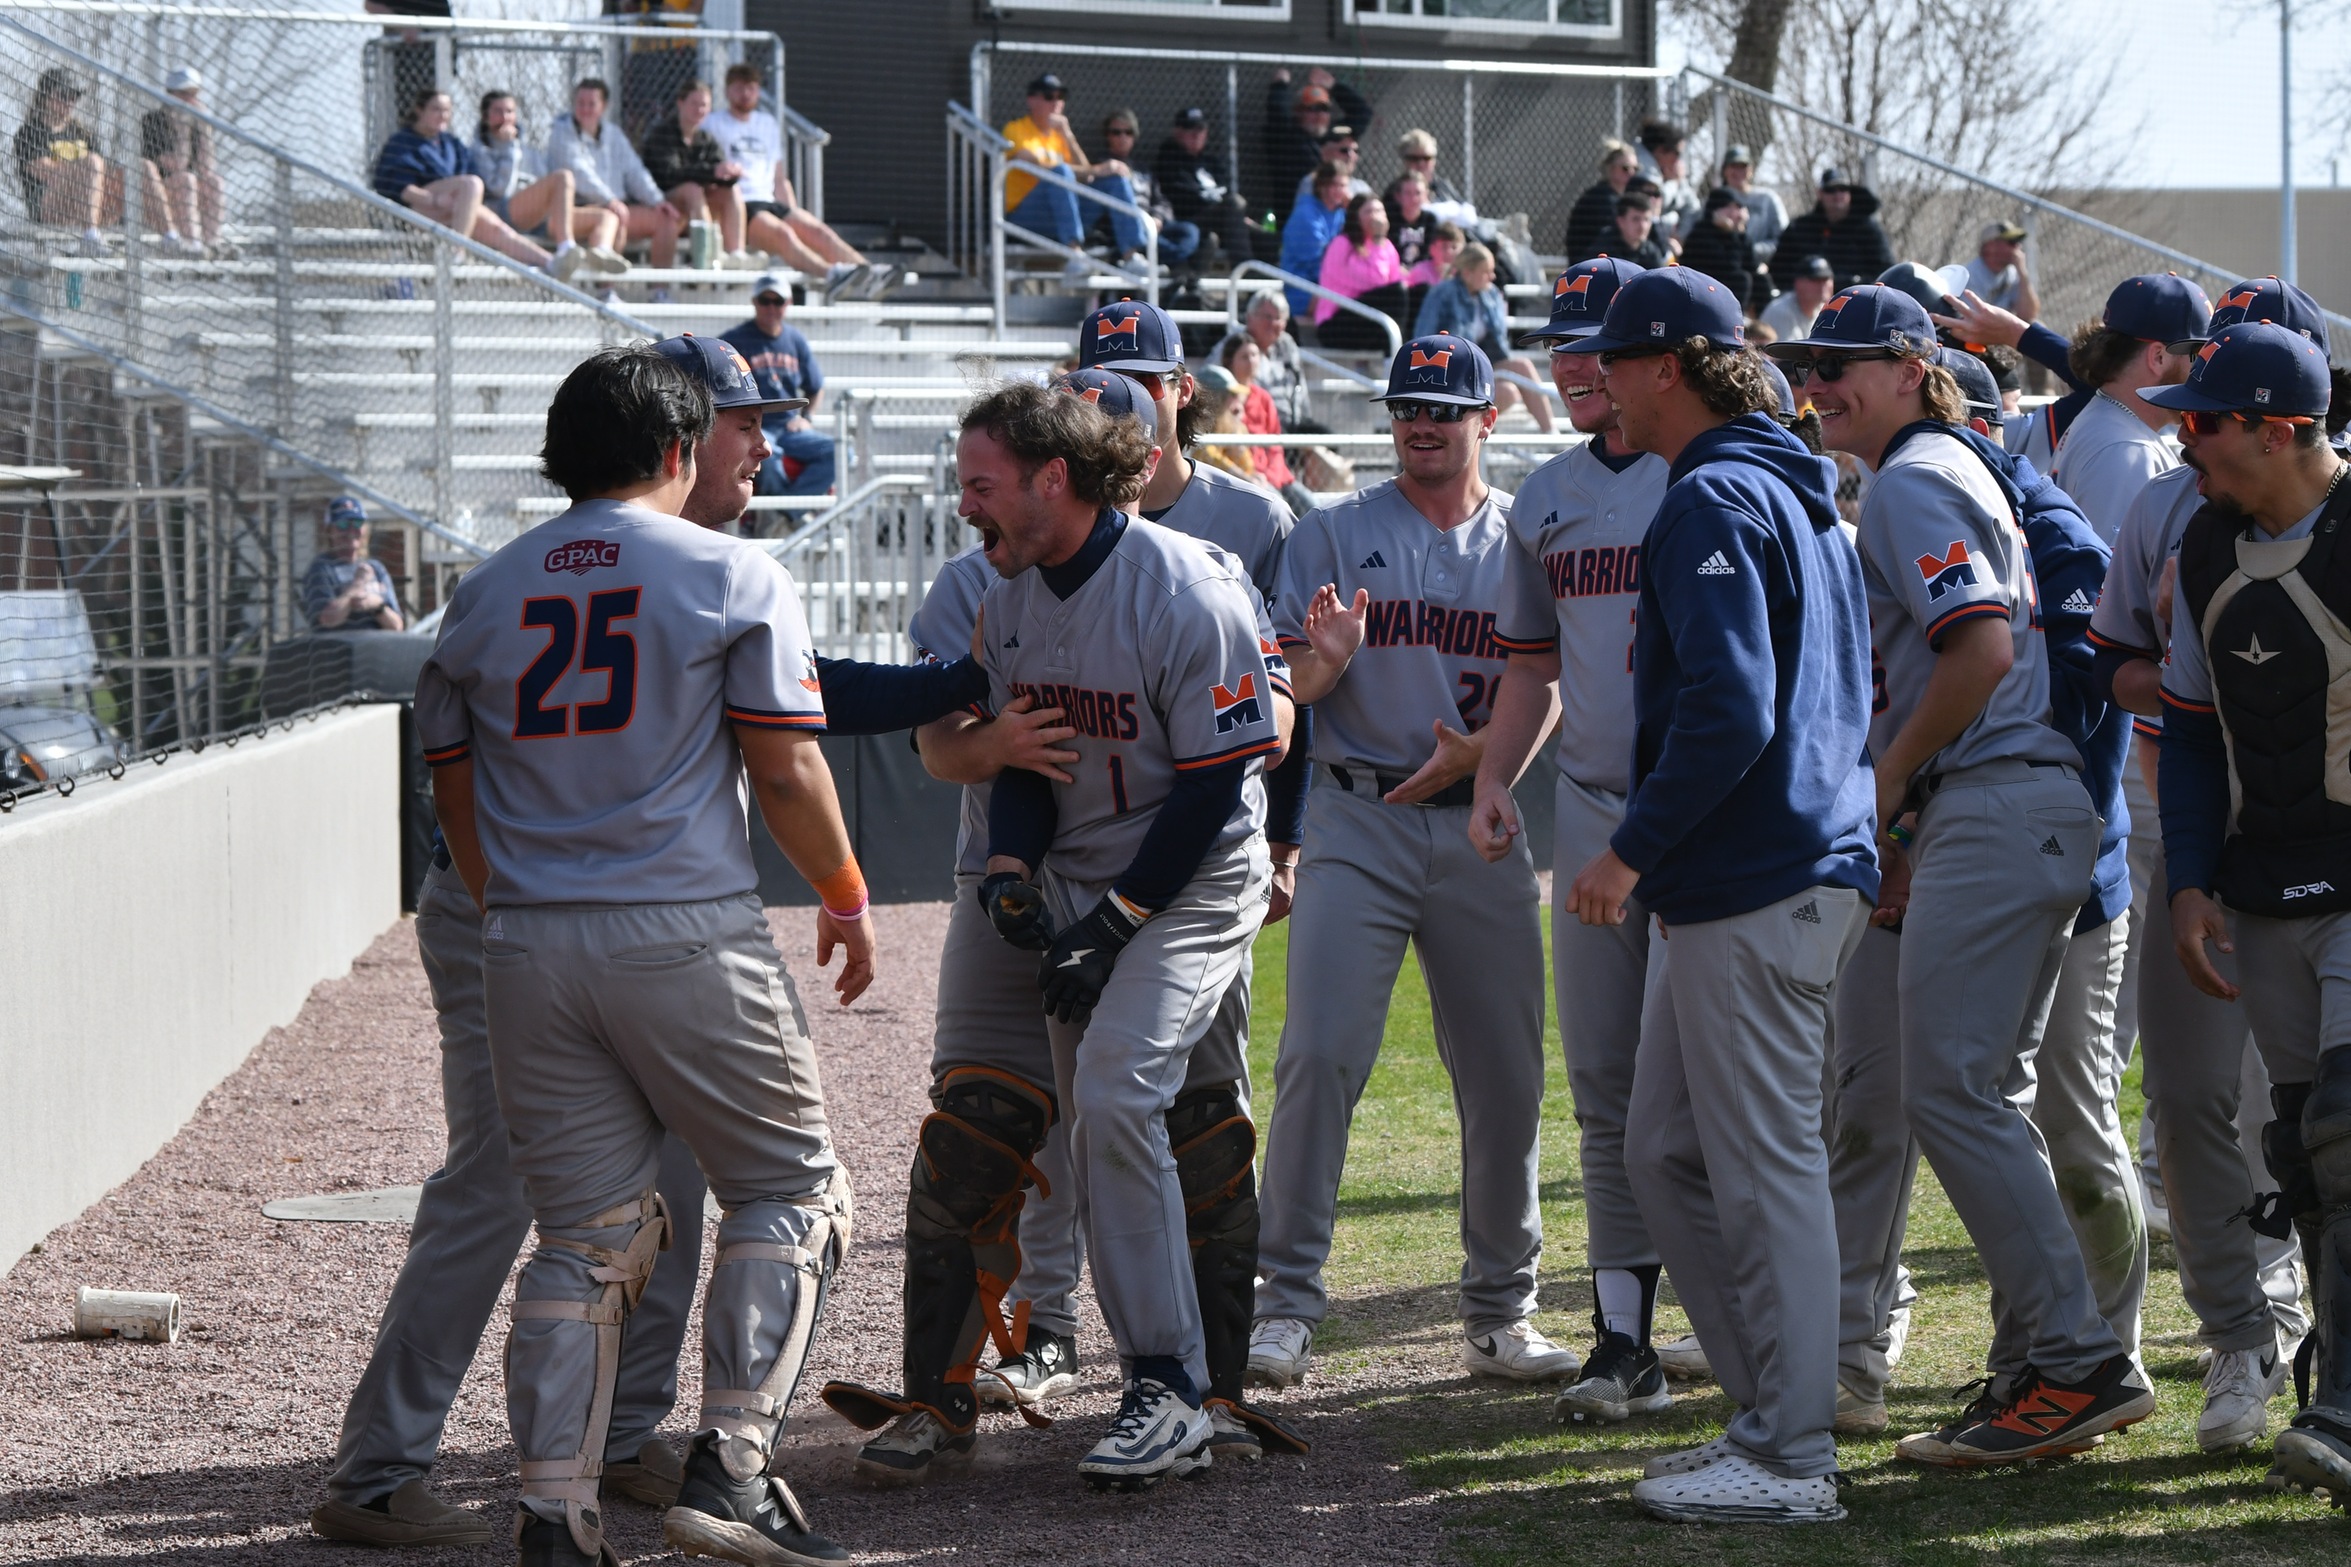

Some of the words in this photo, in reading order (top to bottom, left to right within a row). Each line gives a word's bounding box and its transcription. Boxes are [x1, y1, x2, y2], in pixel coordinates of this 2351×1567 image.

[1096, 316, 1139, 354] M
[1406, 349, 1453, 386] M
[547, 546, 617, 569] GPAC
[1697, 565, 1736, 575] adidas
[1913, 539, 1981, 604] M
[2061, 602, 2094, 612] adidas
[1365, 599, 1509, 660] WARRIOR
[511, 585, 643, 740] 25
[1208, 671, 1265, 736] M
[1108, 754, 1130, 815] 1
[2039, 846, 2065, 857] adidas
[1791, 911, 1822, 925] adidas
